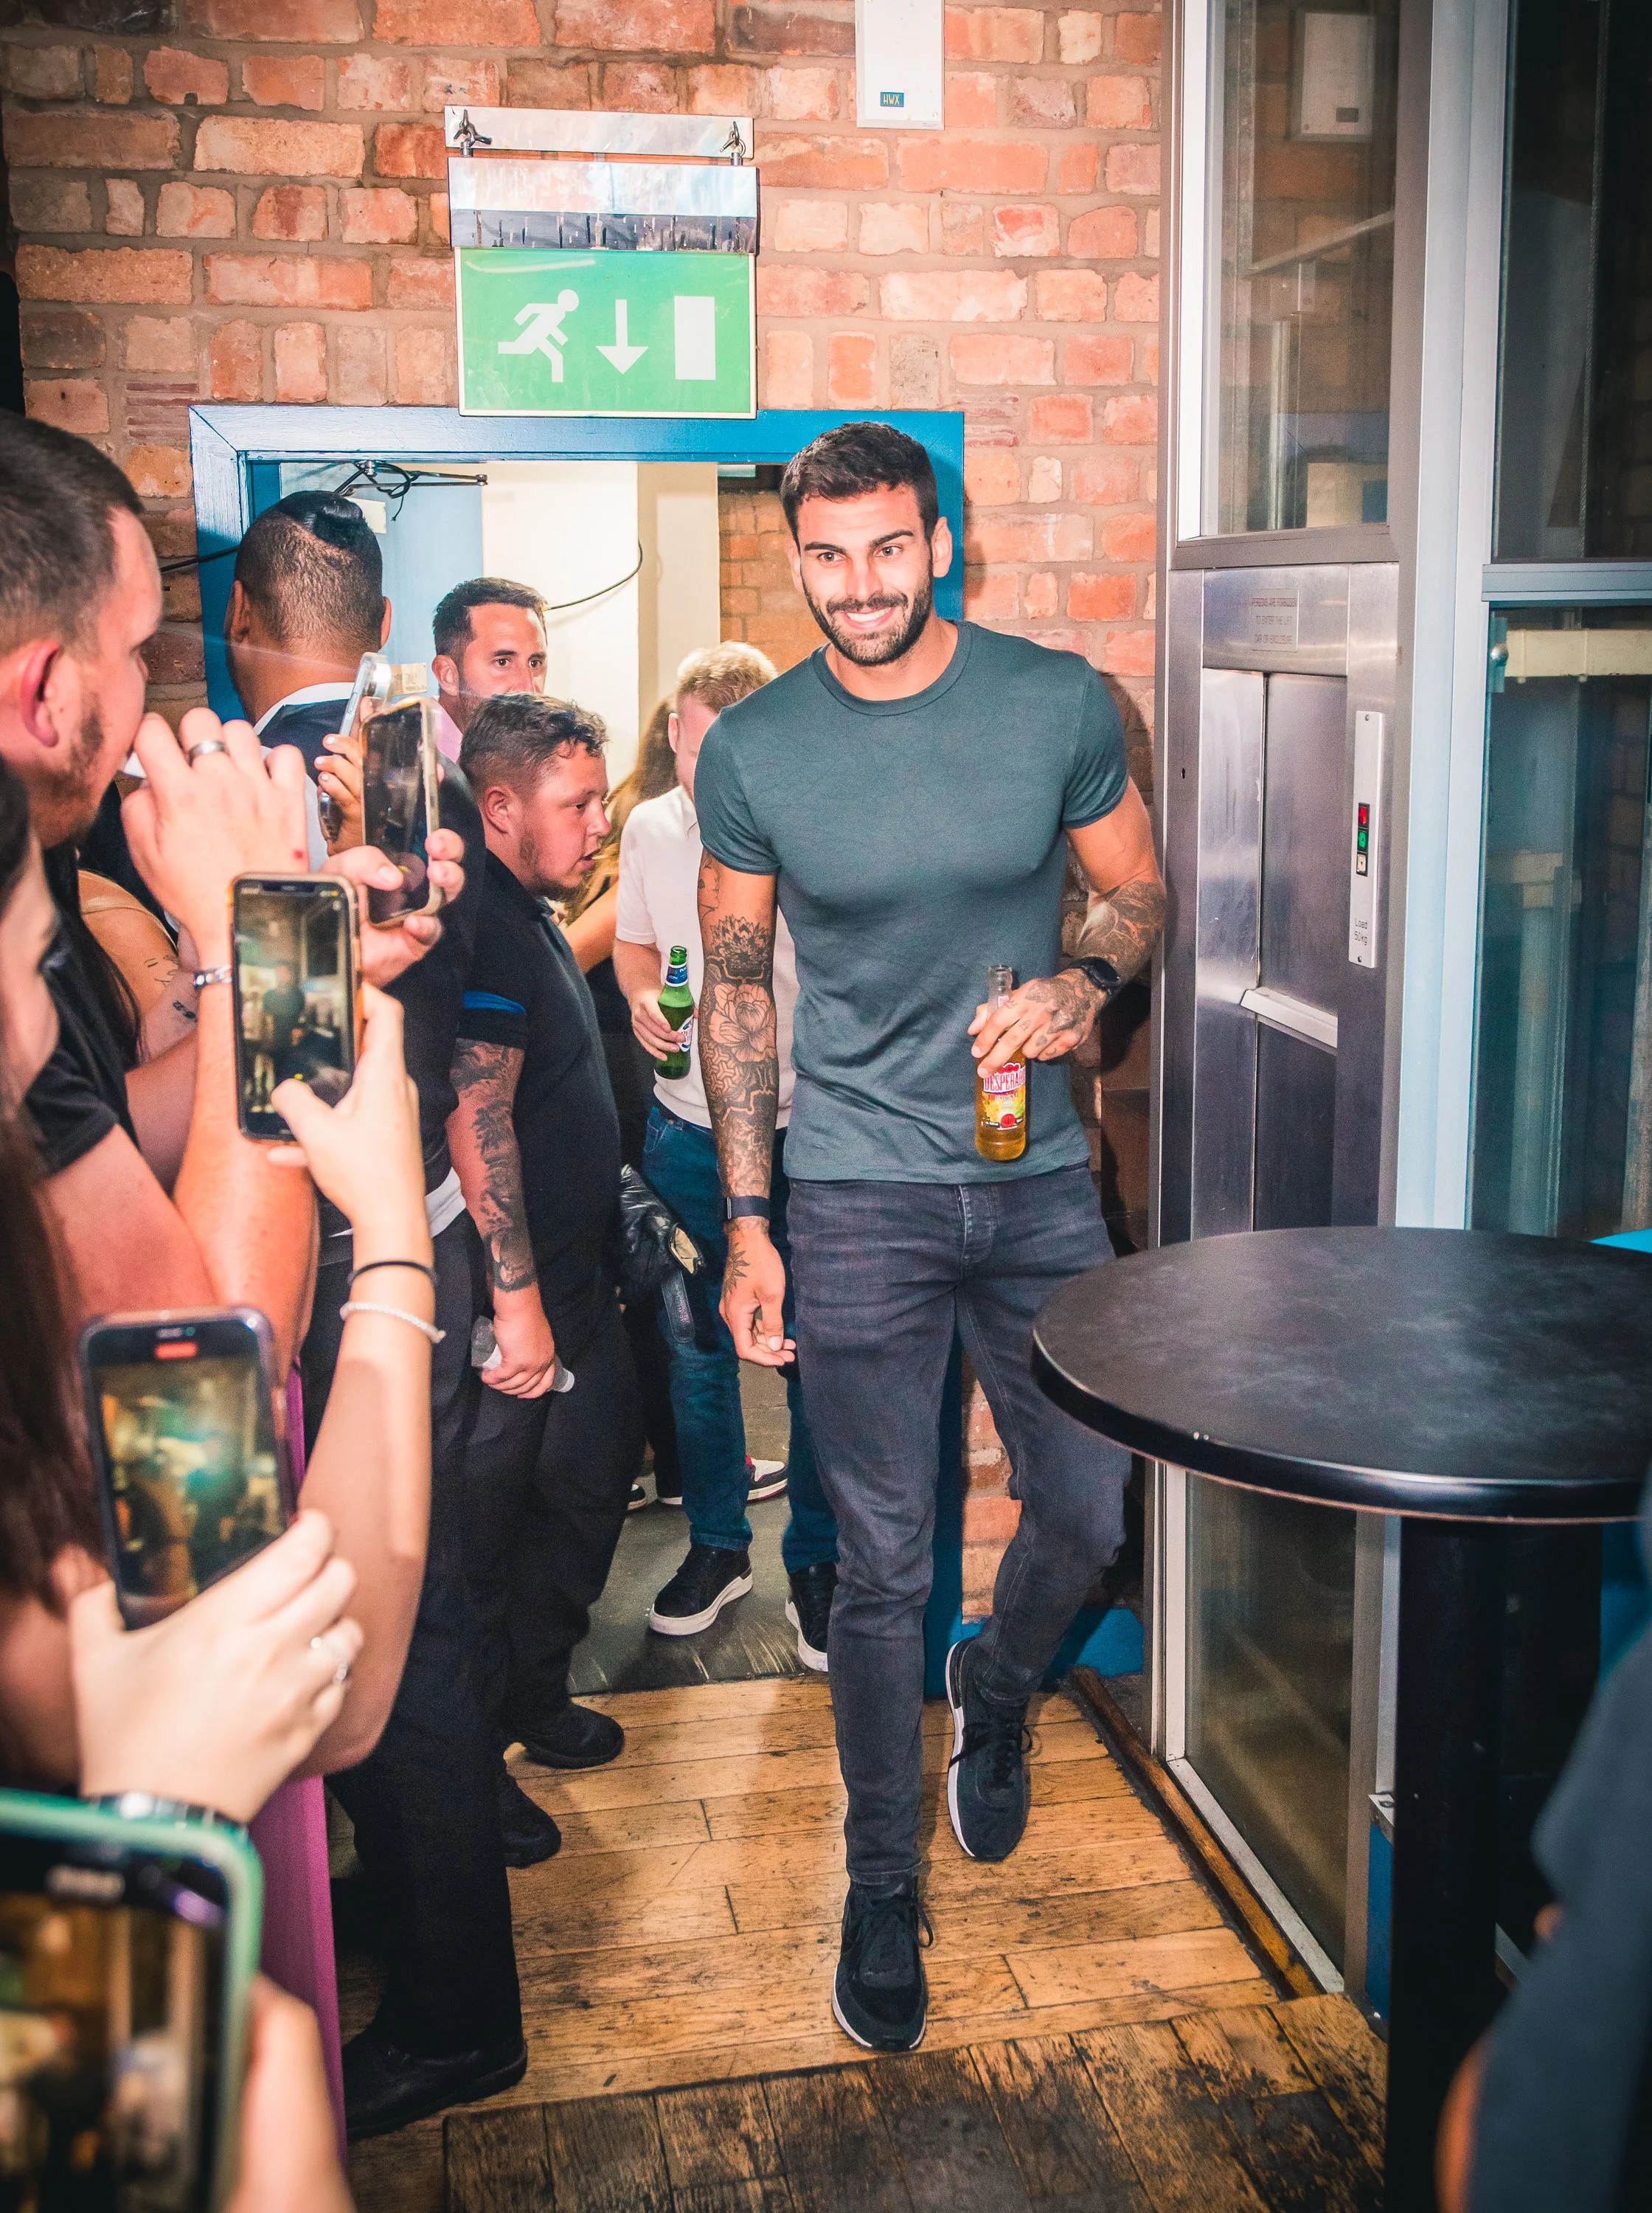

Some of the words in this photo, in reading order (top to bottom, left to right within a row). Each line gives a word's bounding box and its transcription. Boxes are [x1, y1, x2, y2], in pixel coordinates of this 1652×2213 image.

[1252, 598, 1268, 607] PERSONS
[1256, 615, 1260, 626] TO
[1262, 615, 1274, 626] ENTER
[1275, 615, 1283, 626] THE
[1284, 615, 1292, 626] LIFT
[1263, 634, 1268, 644] OR
[1270, 634, 1292, 645] ENCLOSURE
[1355, 917, 1367, 929] Load
[985, 1067, 1026, 1091] DESPERAD
